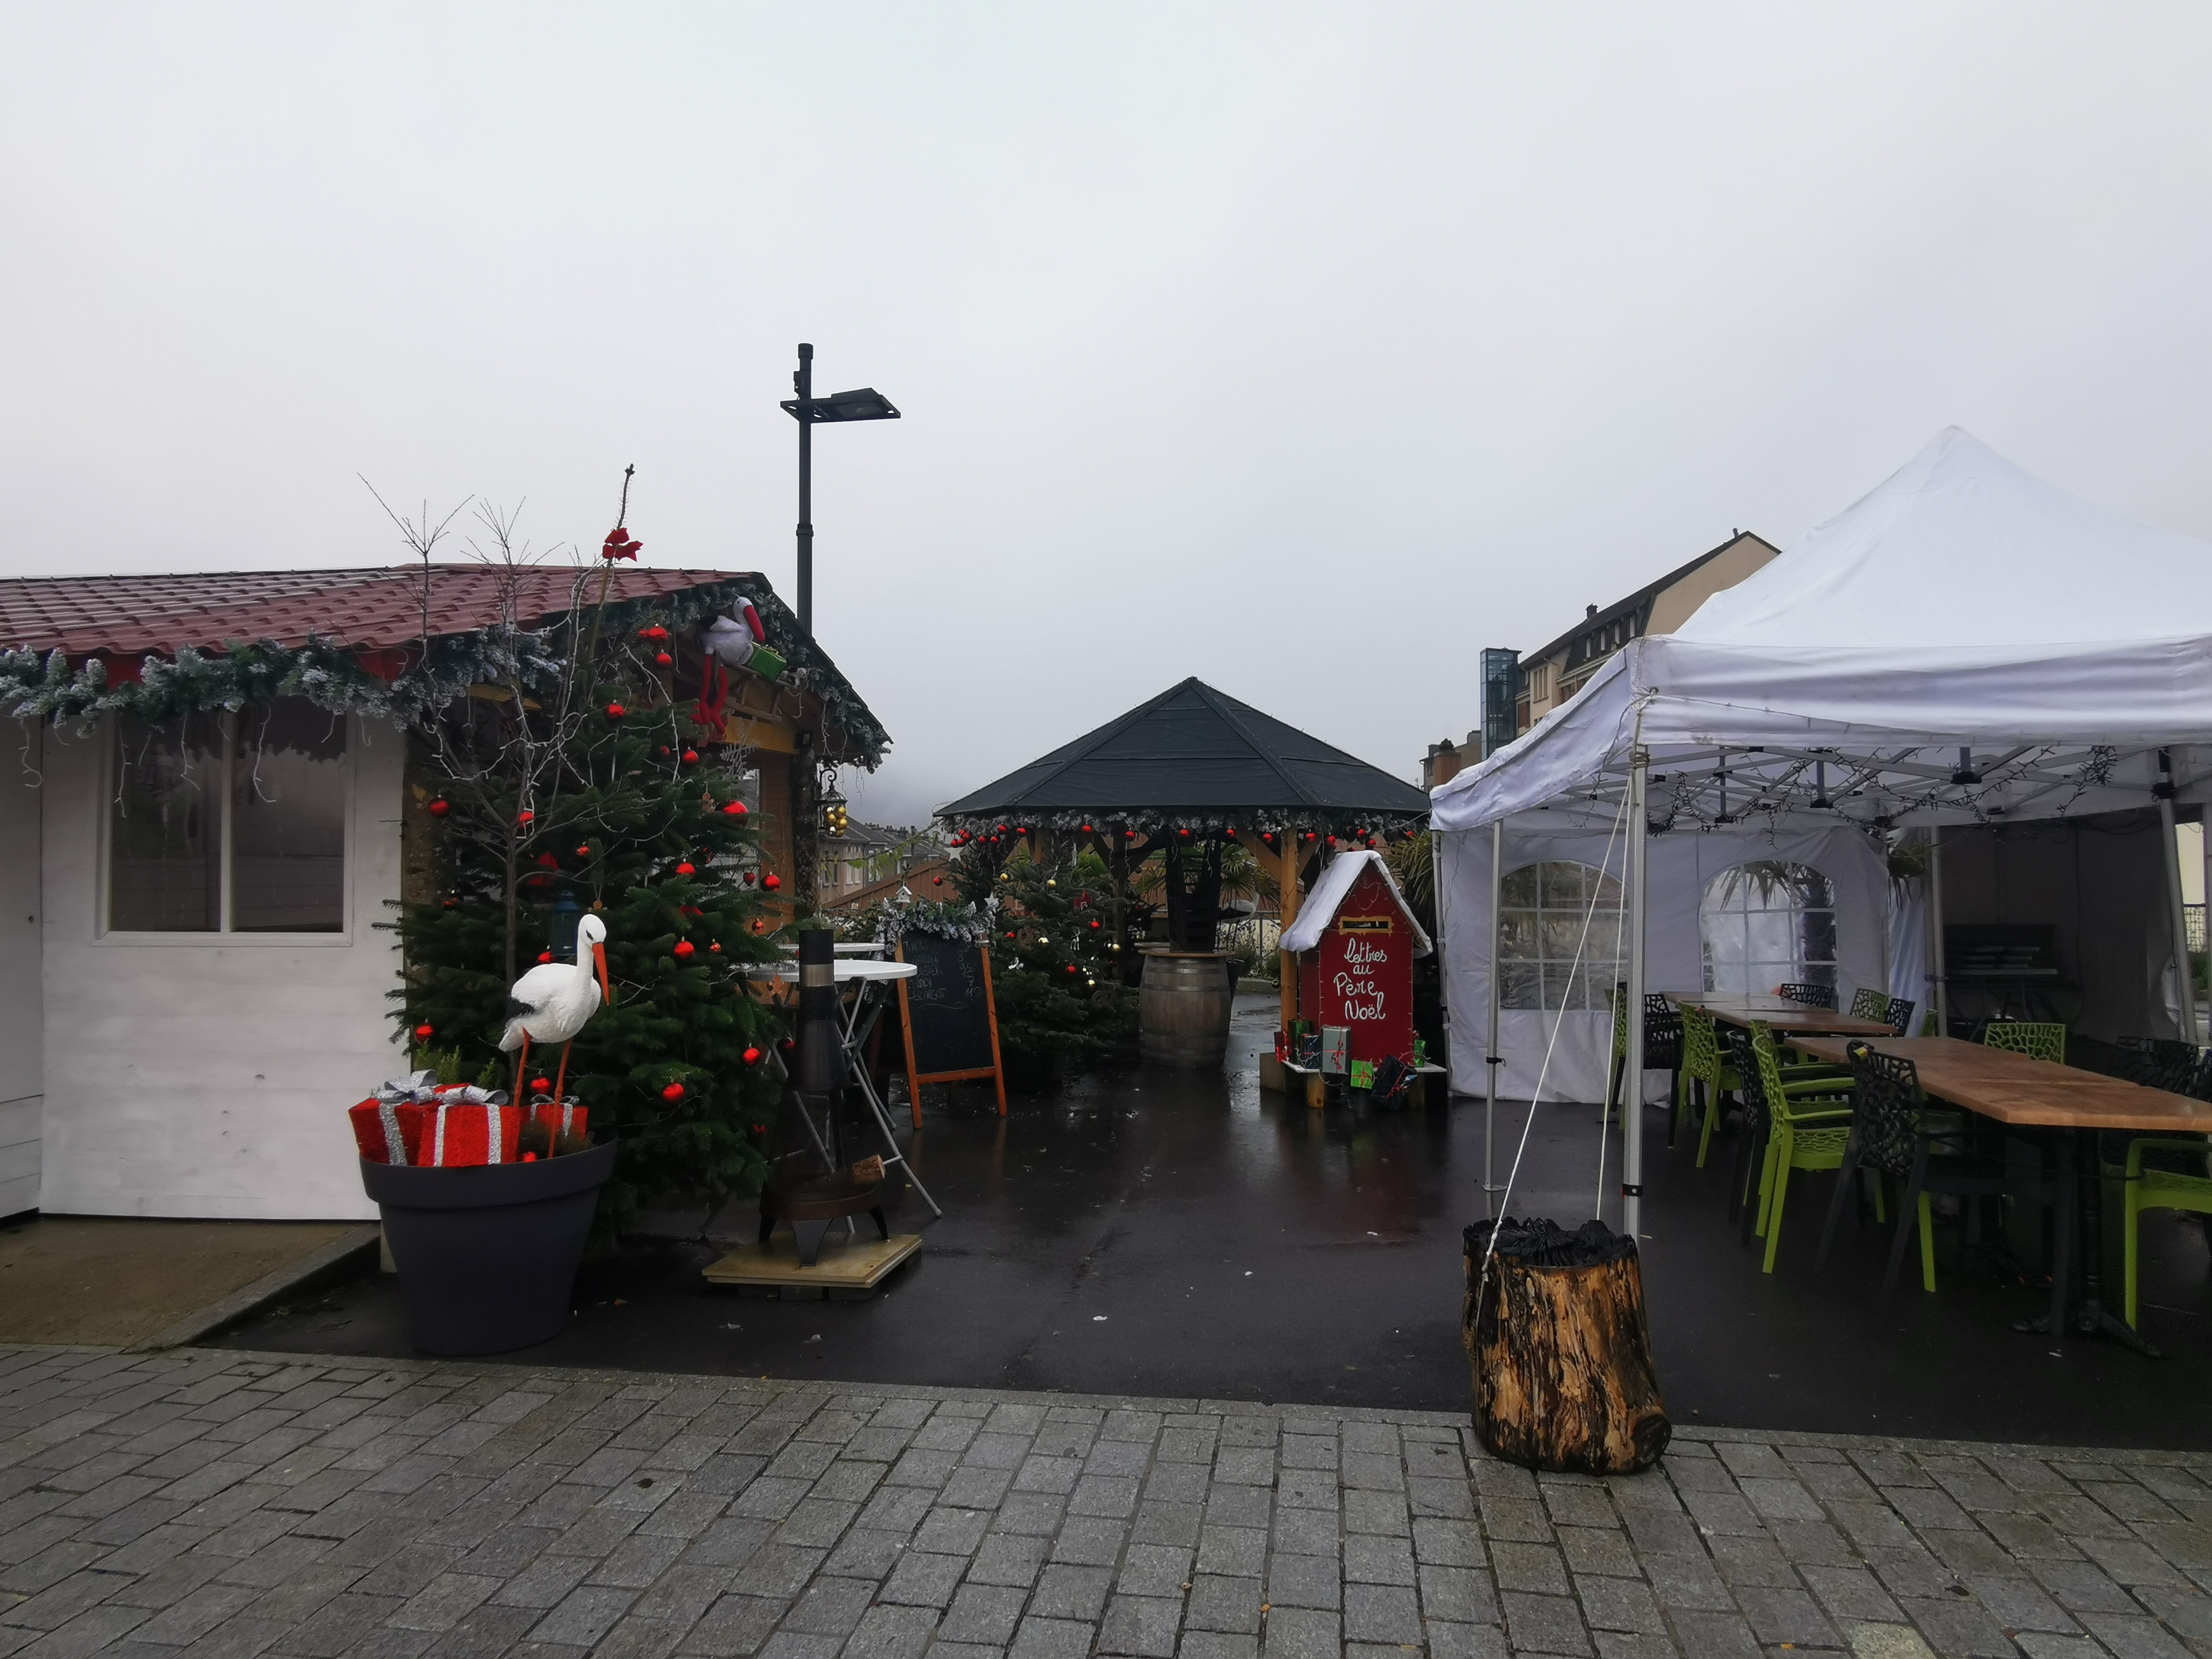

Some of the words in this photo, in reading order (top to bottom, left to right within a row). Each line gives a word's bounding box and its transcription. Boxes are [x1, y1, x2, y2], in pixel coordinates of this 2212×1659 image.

[1344, 938, 1387, 963] lettres
[1353, 964, 1375, 975] au
[1333, 972, 1378, 997] Père
[1344, 991, 1386, 1020] Noël
